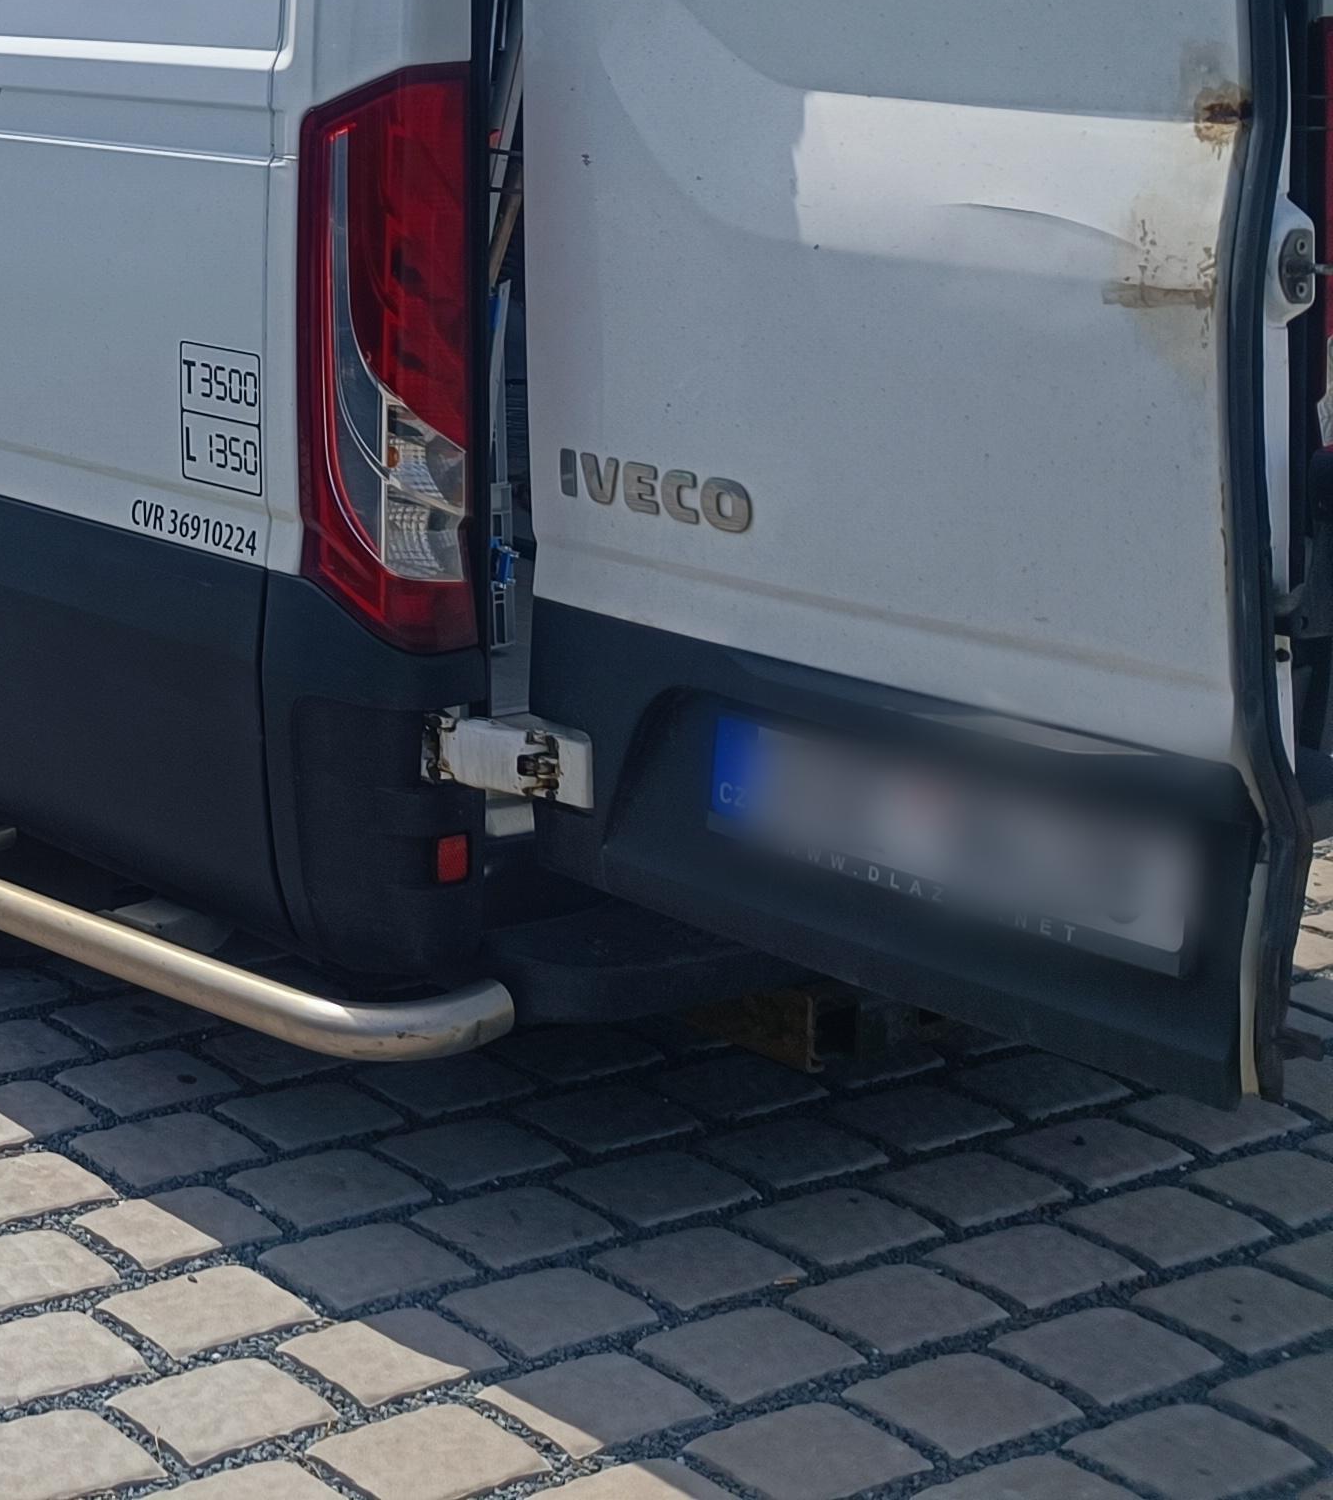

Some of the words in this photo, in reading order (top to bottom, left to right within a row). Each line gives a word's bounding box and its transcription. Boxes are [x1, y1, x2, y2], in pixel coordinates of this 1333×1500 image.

[560, 448, 753, 534] IVECO
[131, 499, 164, 531] CVR
[168, 509, 257, 556] 36910224
